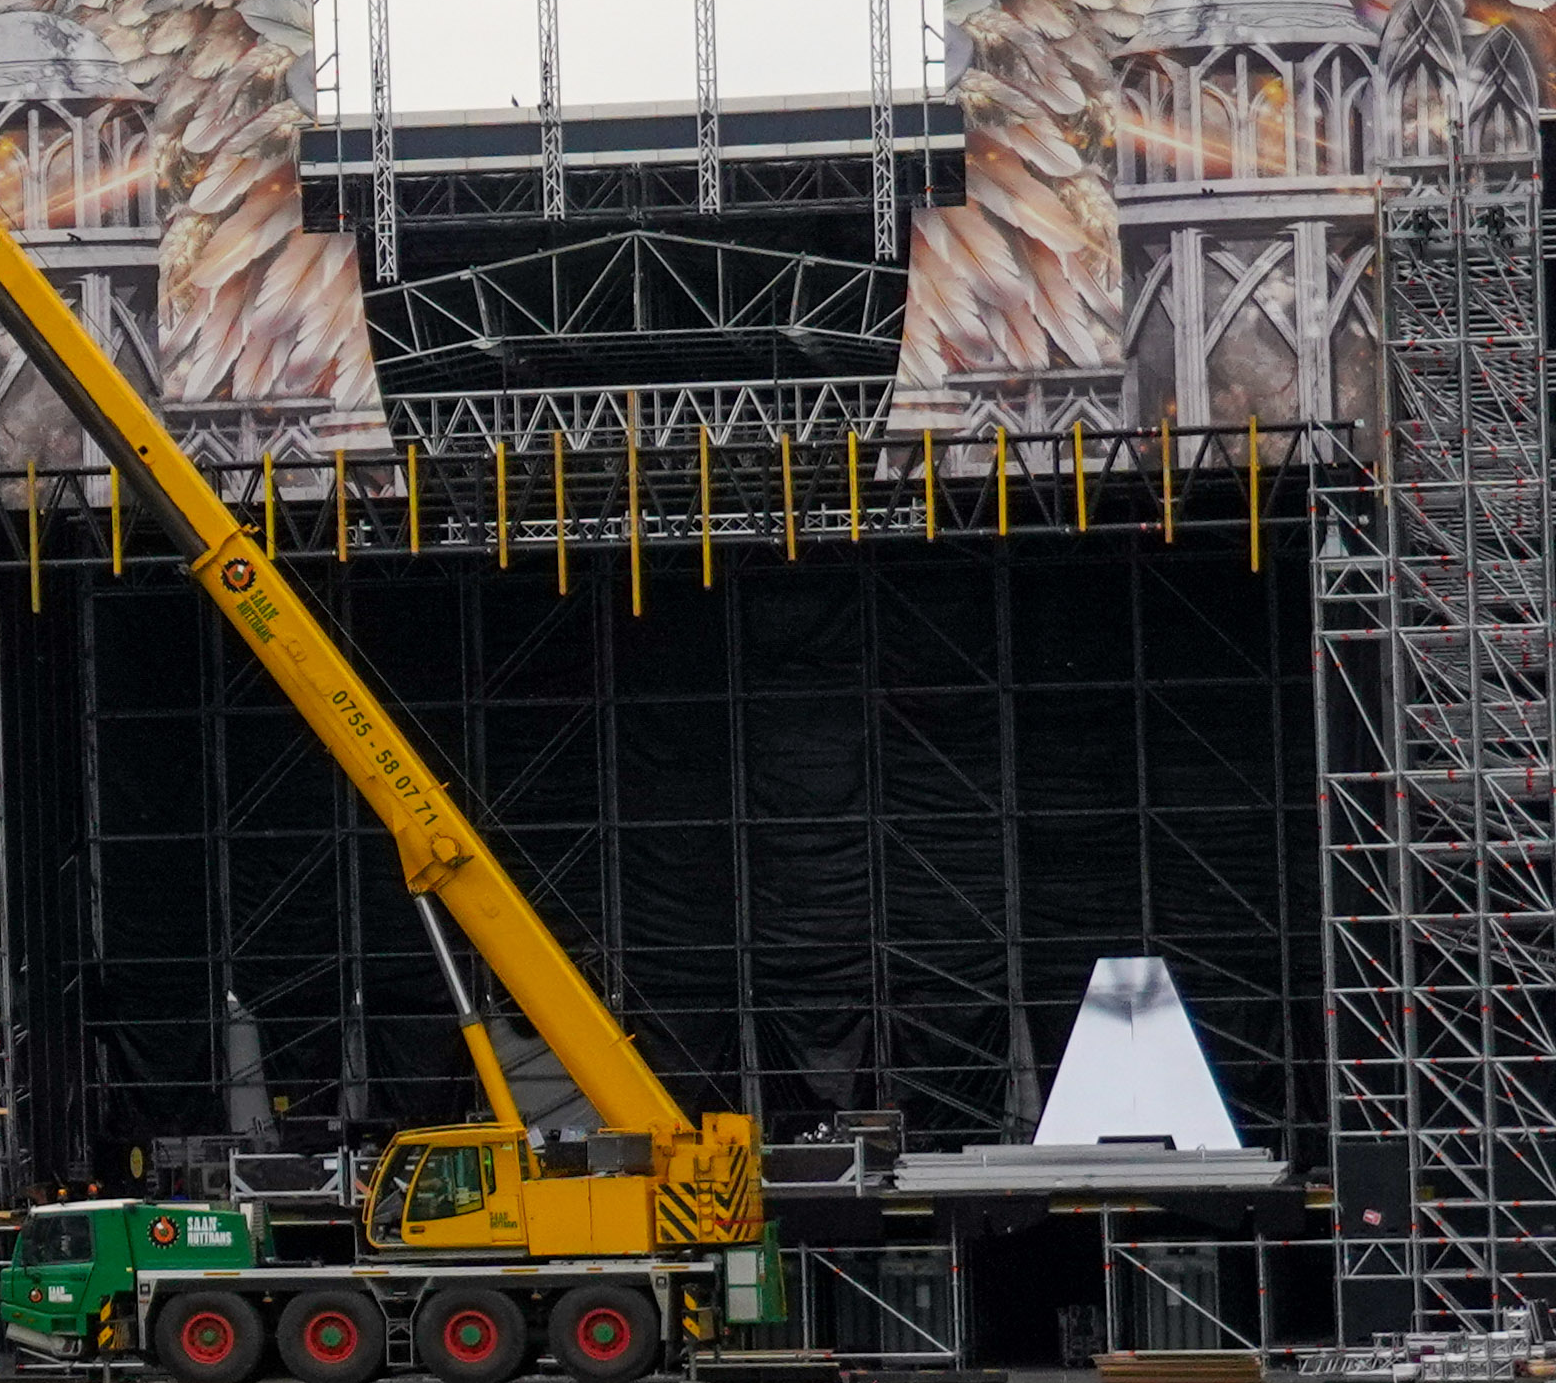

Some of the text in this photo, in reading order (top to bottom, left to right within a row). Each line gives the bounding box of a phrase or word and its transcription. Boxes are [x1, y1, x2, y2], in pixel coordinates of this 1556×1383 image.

[332, 690, 372, 738] 0755
[376, 750, 400, 775] 58
[395, 778, 420, 799] 07
[414, 801, 439, 826] 71
